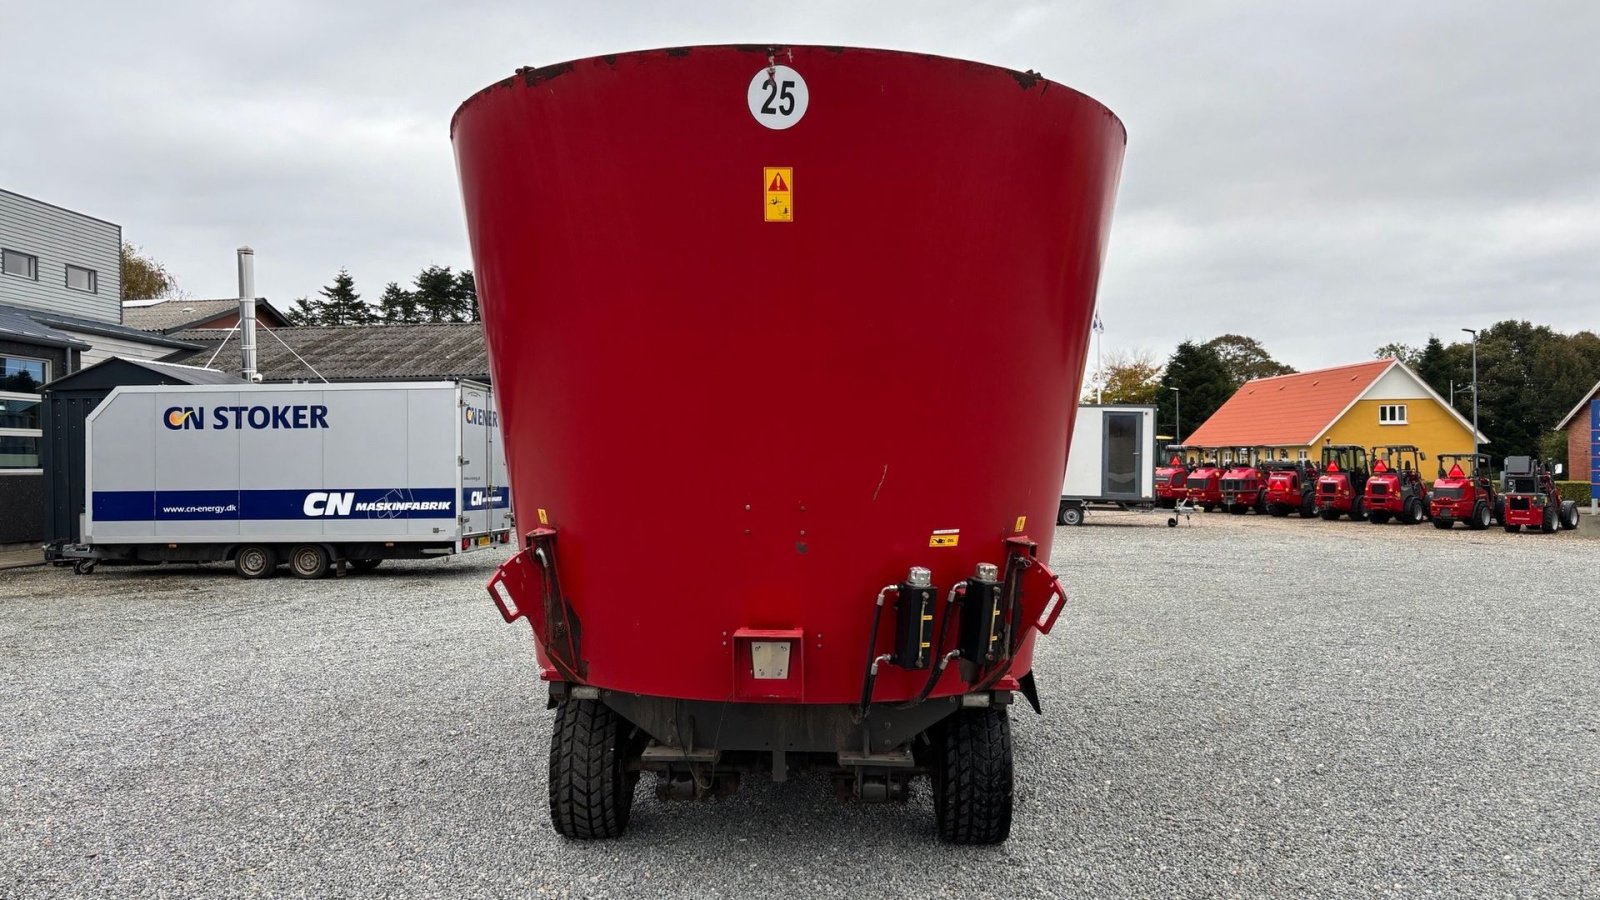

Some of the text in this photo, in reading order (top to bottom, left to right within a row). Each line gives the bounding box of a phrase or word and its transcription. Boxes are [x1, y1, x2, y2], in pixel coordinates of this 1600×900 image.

[760, 79, 796, 117] 25
[163, 405, 330, 431] CN STOKER
[478, 408, 498, 428] ENER
[162, 504, 237, 514] www.cn-energy.dk
[303, 492, 452, 517] CN MASKINFABRIK
